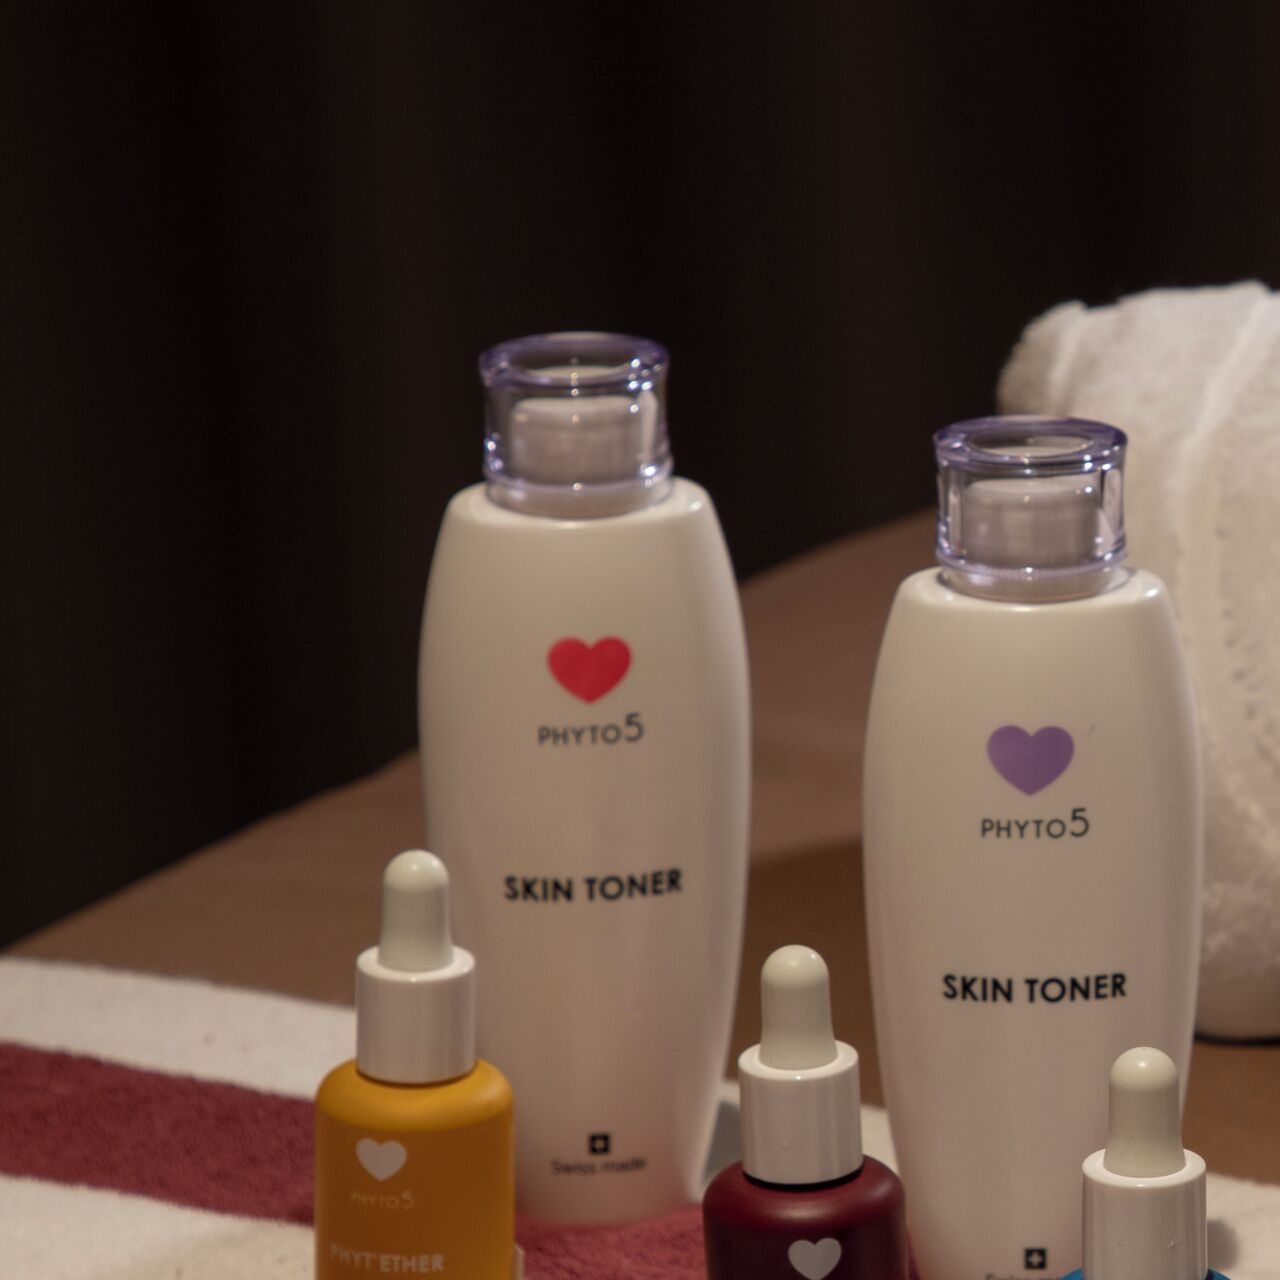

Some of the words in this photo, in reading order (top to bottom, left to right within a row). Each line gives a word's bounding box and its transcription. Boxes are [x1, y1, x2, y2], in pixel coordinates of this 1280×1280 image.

[980, 807, 1090, 840] PHYTO5
[503, 874, 574, 903] SKIN
[583, 867, 683, 903] TONER
[943, 973, 1013, 1003] SKIN
[1024, 972, 1127, 1003] TONER
